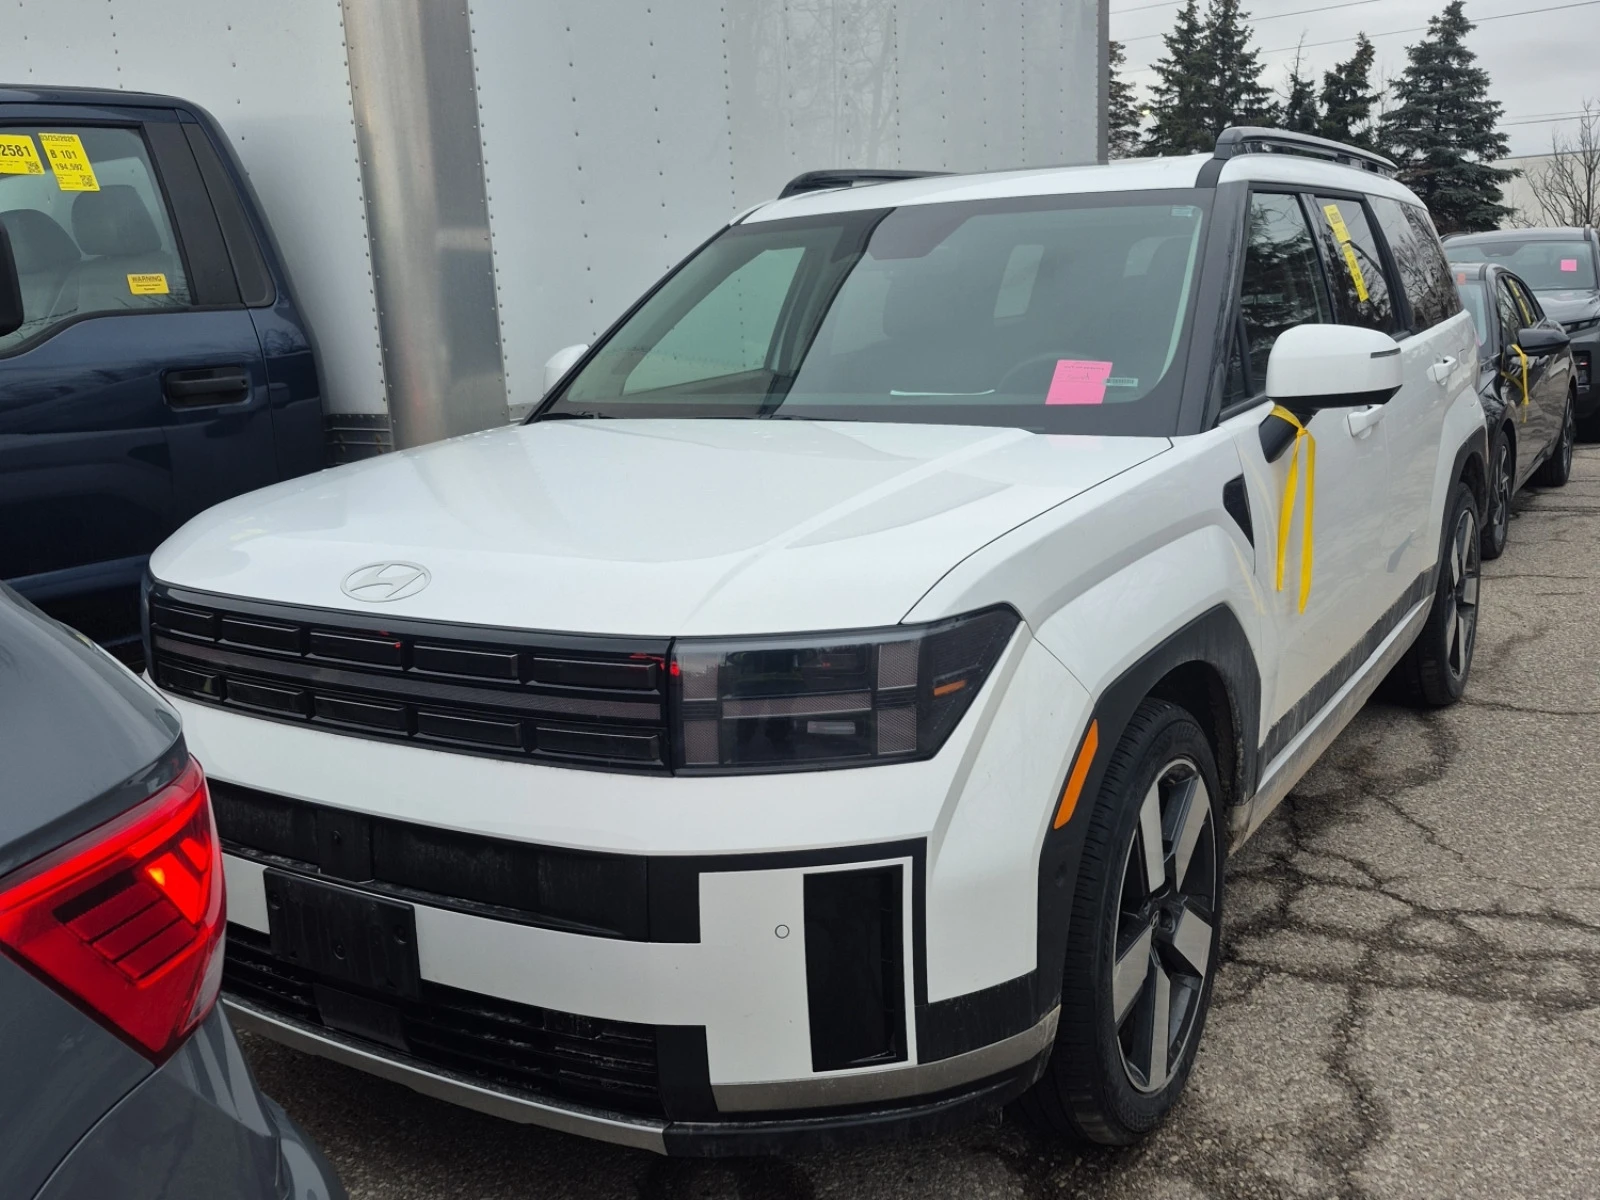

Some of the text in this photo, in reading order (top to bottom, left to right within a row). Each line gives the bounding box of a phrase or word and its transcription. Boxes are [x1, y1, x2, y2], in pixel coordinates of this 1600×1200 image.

[50, 149, 78, 159] B 101
[132, 275, 162, 283] WARNING
